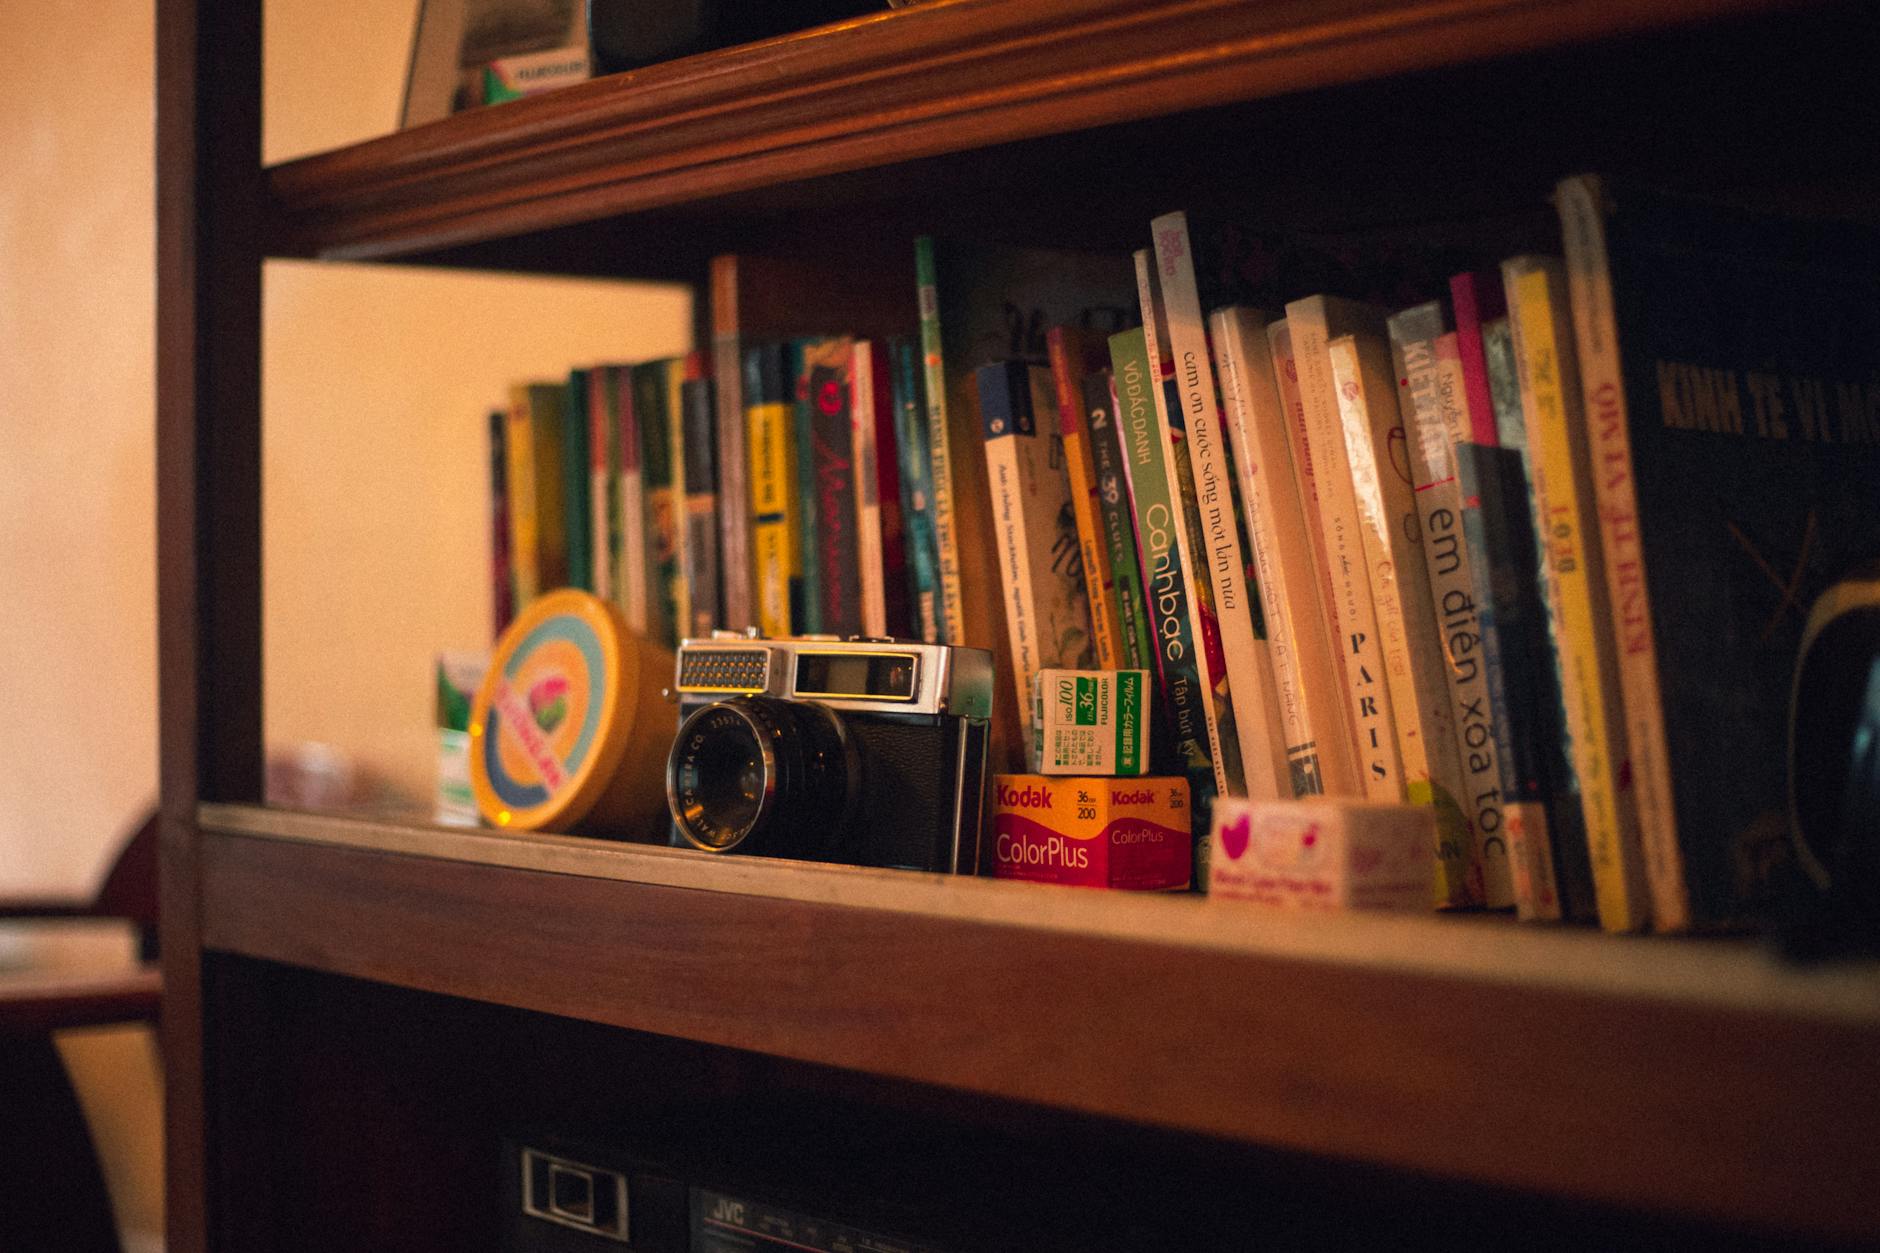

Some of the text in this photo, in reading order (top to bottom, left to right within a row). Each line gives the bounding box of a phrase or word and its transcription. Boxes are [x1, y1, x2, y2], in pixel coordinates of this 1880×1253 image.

[1102, 474, 1120, 504] 39
[1429, 508, 1460, 575] em
[1442, 590, 1481, 685] điên
[1059, 680, 1073, 721] ISO 100
[1079, 692, 1095, 711] 36
[1100, 678, 1109, 726] FUJICOLOR
[1350, 632, 1387, 782] PARIS
[996, 783, 1053, 809] Kodak
[1077, 790, 1089, 803] 36
[1111, 789, 1155, 806] Kodak
[1077, 807, 1096, 820] 200
[1111, 828, 1164, 845] ColorPlus
[996, 833, 1089, 869] ColorPlus
[713, 1199, 745, 1226] JVC
